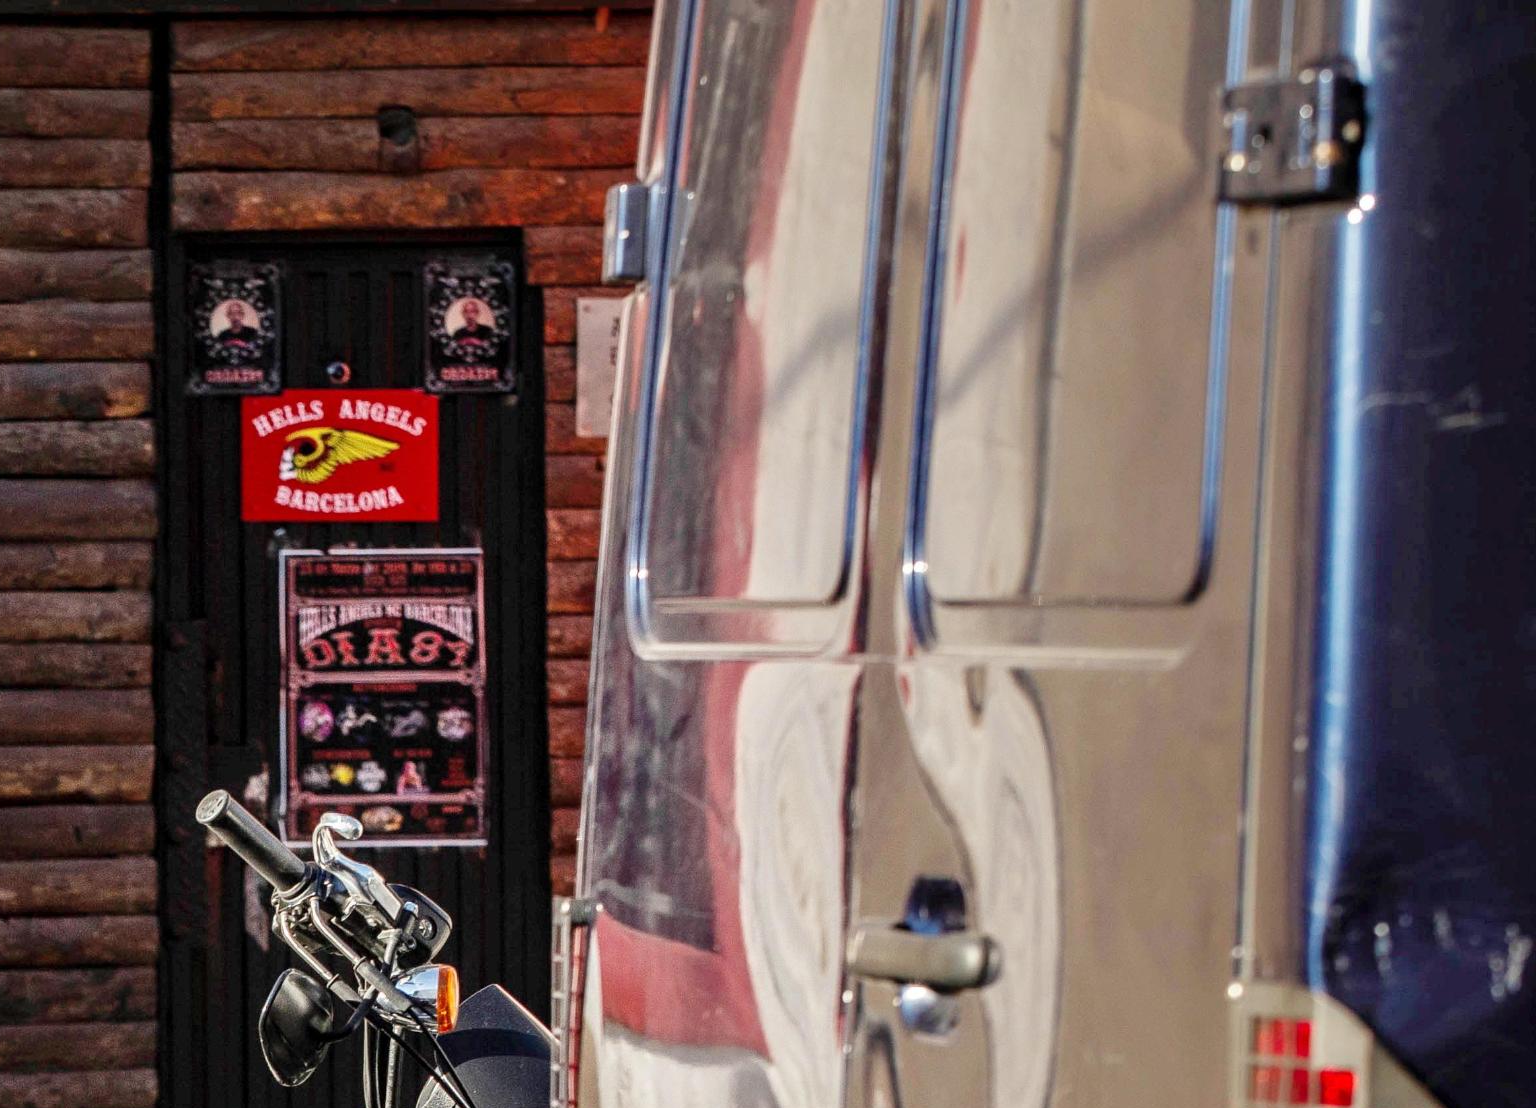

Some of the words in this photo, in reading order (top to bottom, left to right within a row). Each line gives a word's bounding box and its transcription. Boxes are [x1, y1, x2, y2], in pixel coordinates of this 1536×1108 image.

[252, 400, 325, 437] HELLS
[339, 399, 427, 437] ANGELS
[275, 485, 404, 514] BARCELONA
